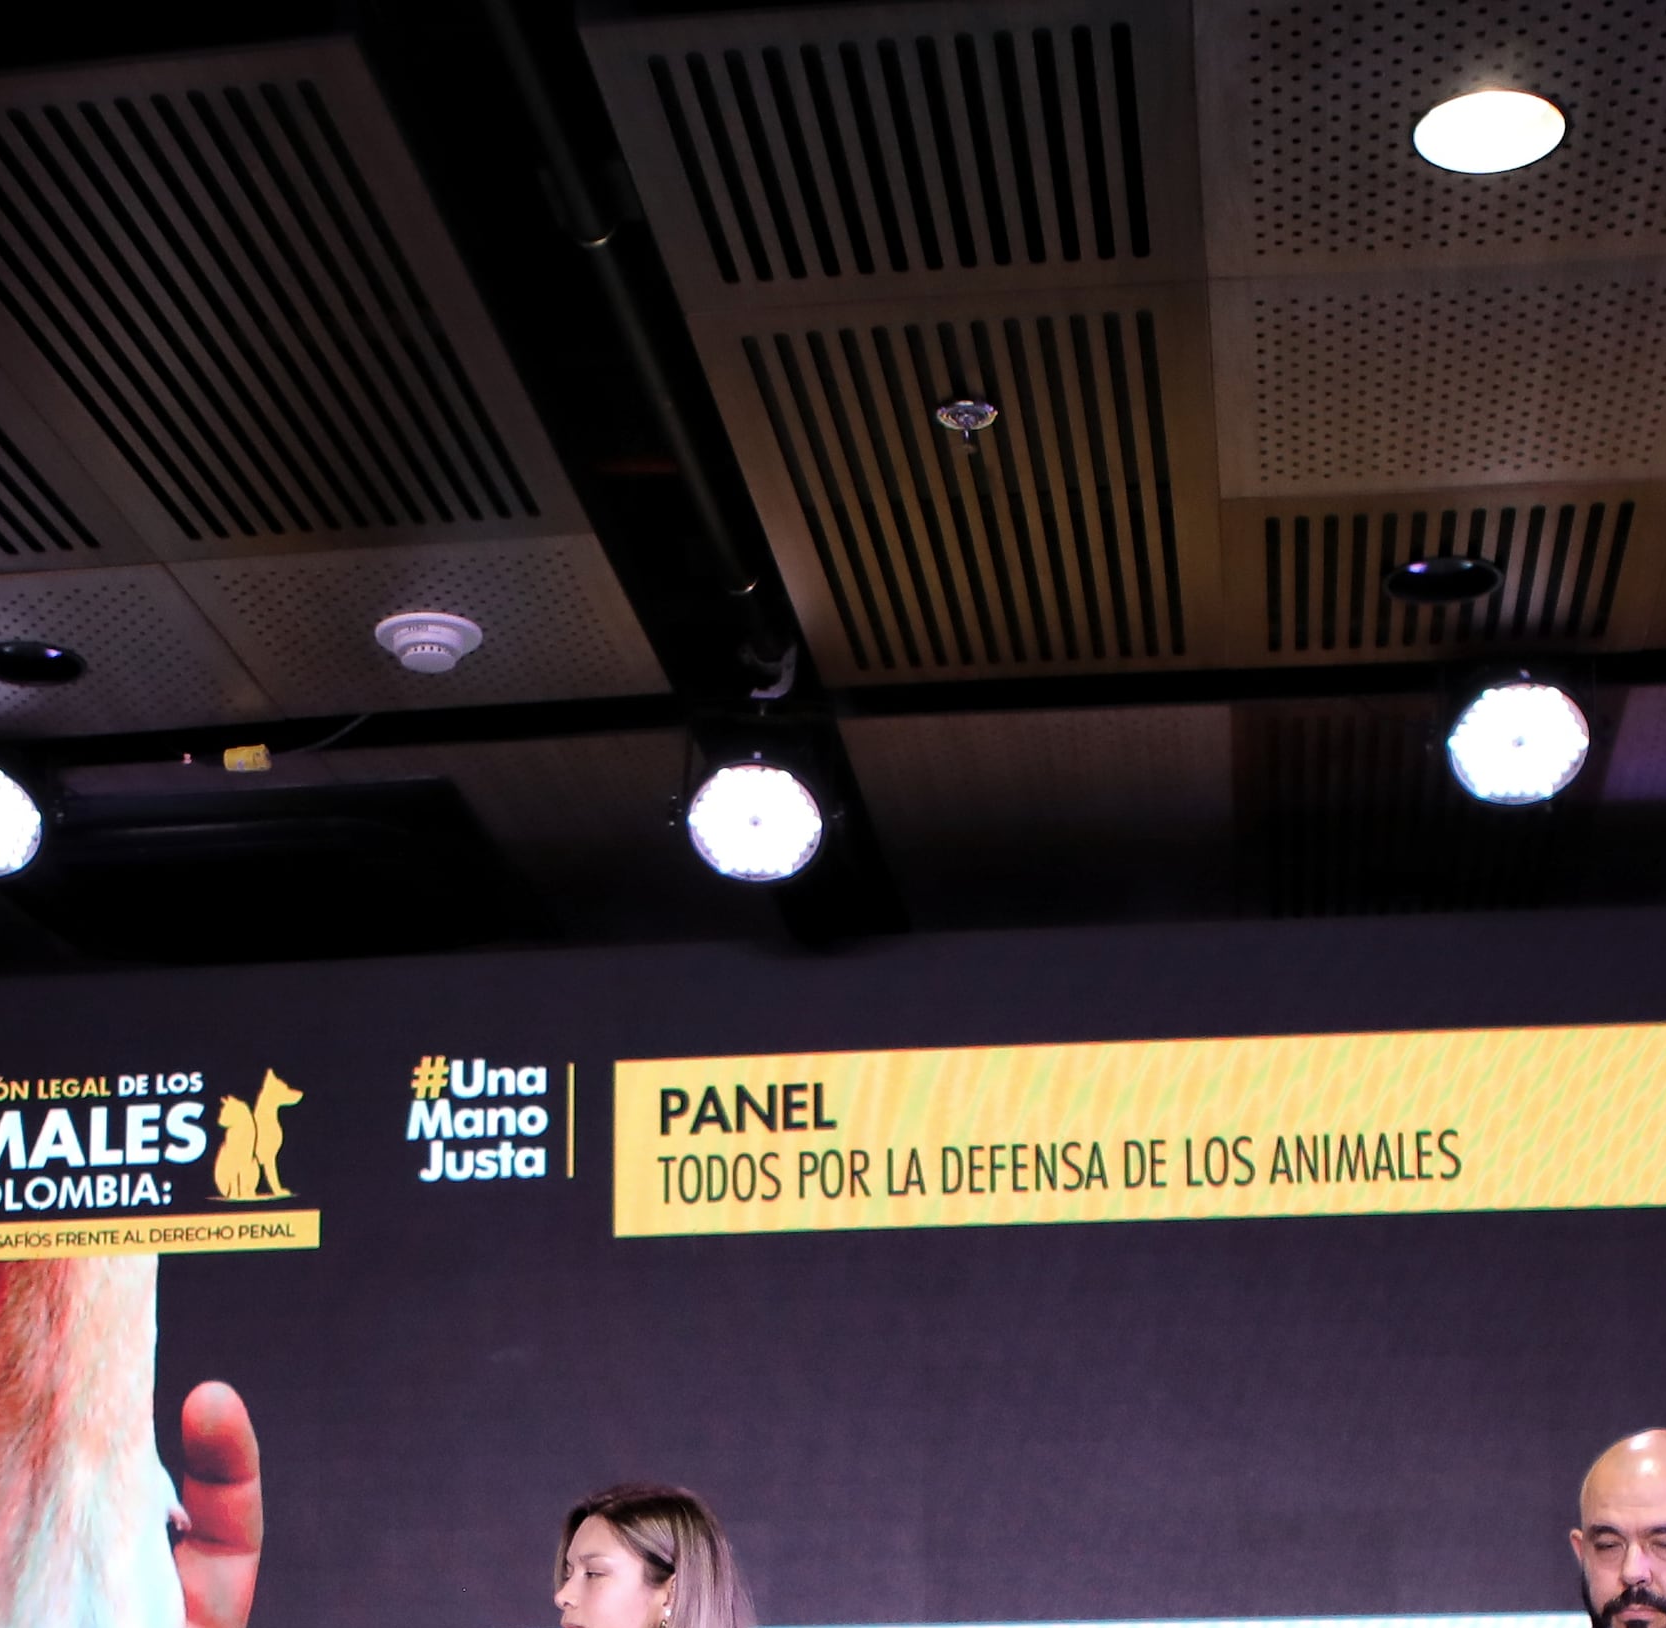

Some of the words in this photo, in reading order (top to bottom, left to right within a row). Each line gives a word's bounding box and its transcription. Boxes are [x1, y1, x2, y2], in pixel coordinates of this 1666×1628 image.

[37, 1076, 111, 1102] LEGAL
[118, 1075, 148, 1097] DE
[155, 1072, 204, 1095] LOS
[411, 1055, 548, 1099] #Una
[406, 1100, 549, 1140] Mano
[658, 1081, 837, 1136] PANEL
[420, 1141, 546, 1182] Justa
[658, 1150, 783, 1206] TODOS
[796, 1150, 872, 1201] POR
[886, 1148, 927, 1198] LA
[940, 1140, 1110, 1195] DEFENSA
[1123, 1140, 1170, 1190] DE
[1184, 1135, 1256, 1188] LOS
[1268, 1129, 1463, 1184] ANIMALES
[55, 1230, 120, 1247] FRENTE
[123, 1228, 145, 1244] AL
[149, 1225, 234, 1243] DERECHO
[239, 1223, 295, 1240] PENAL
